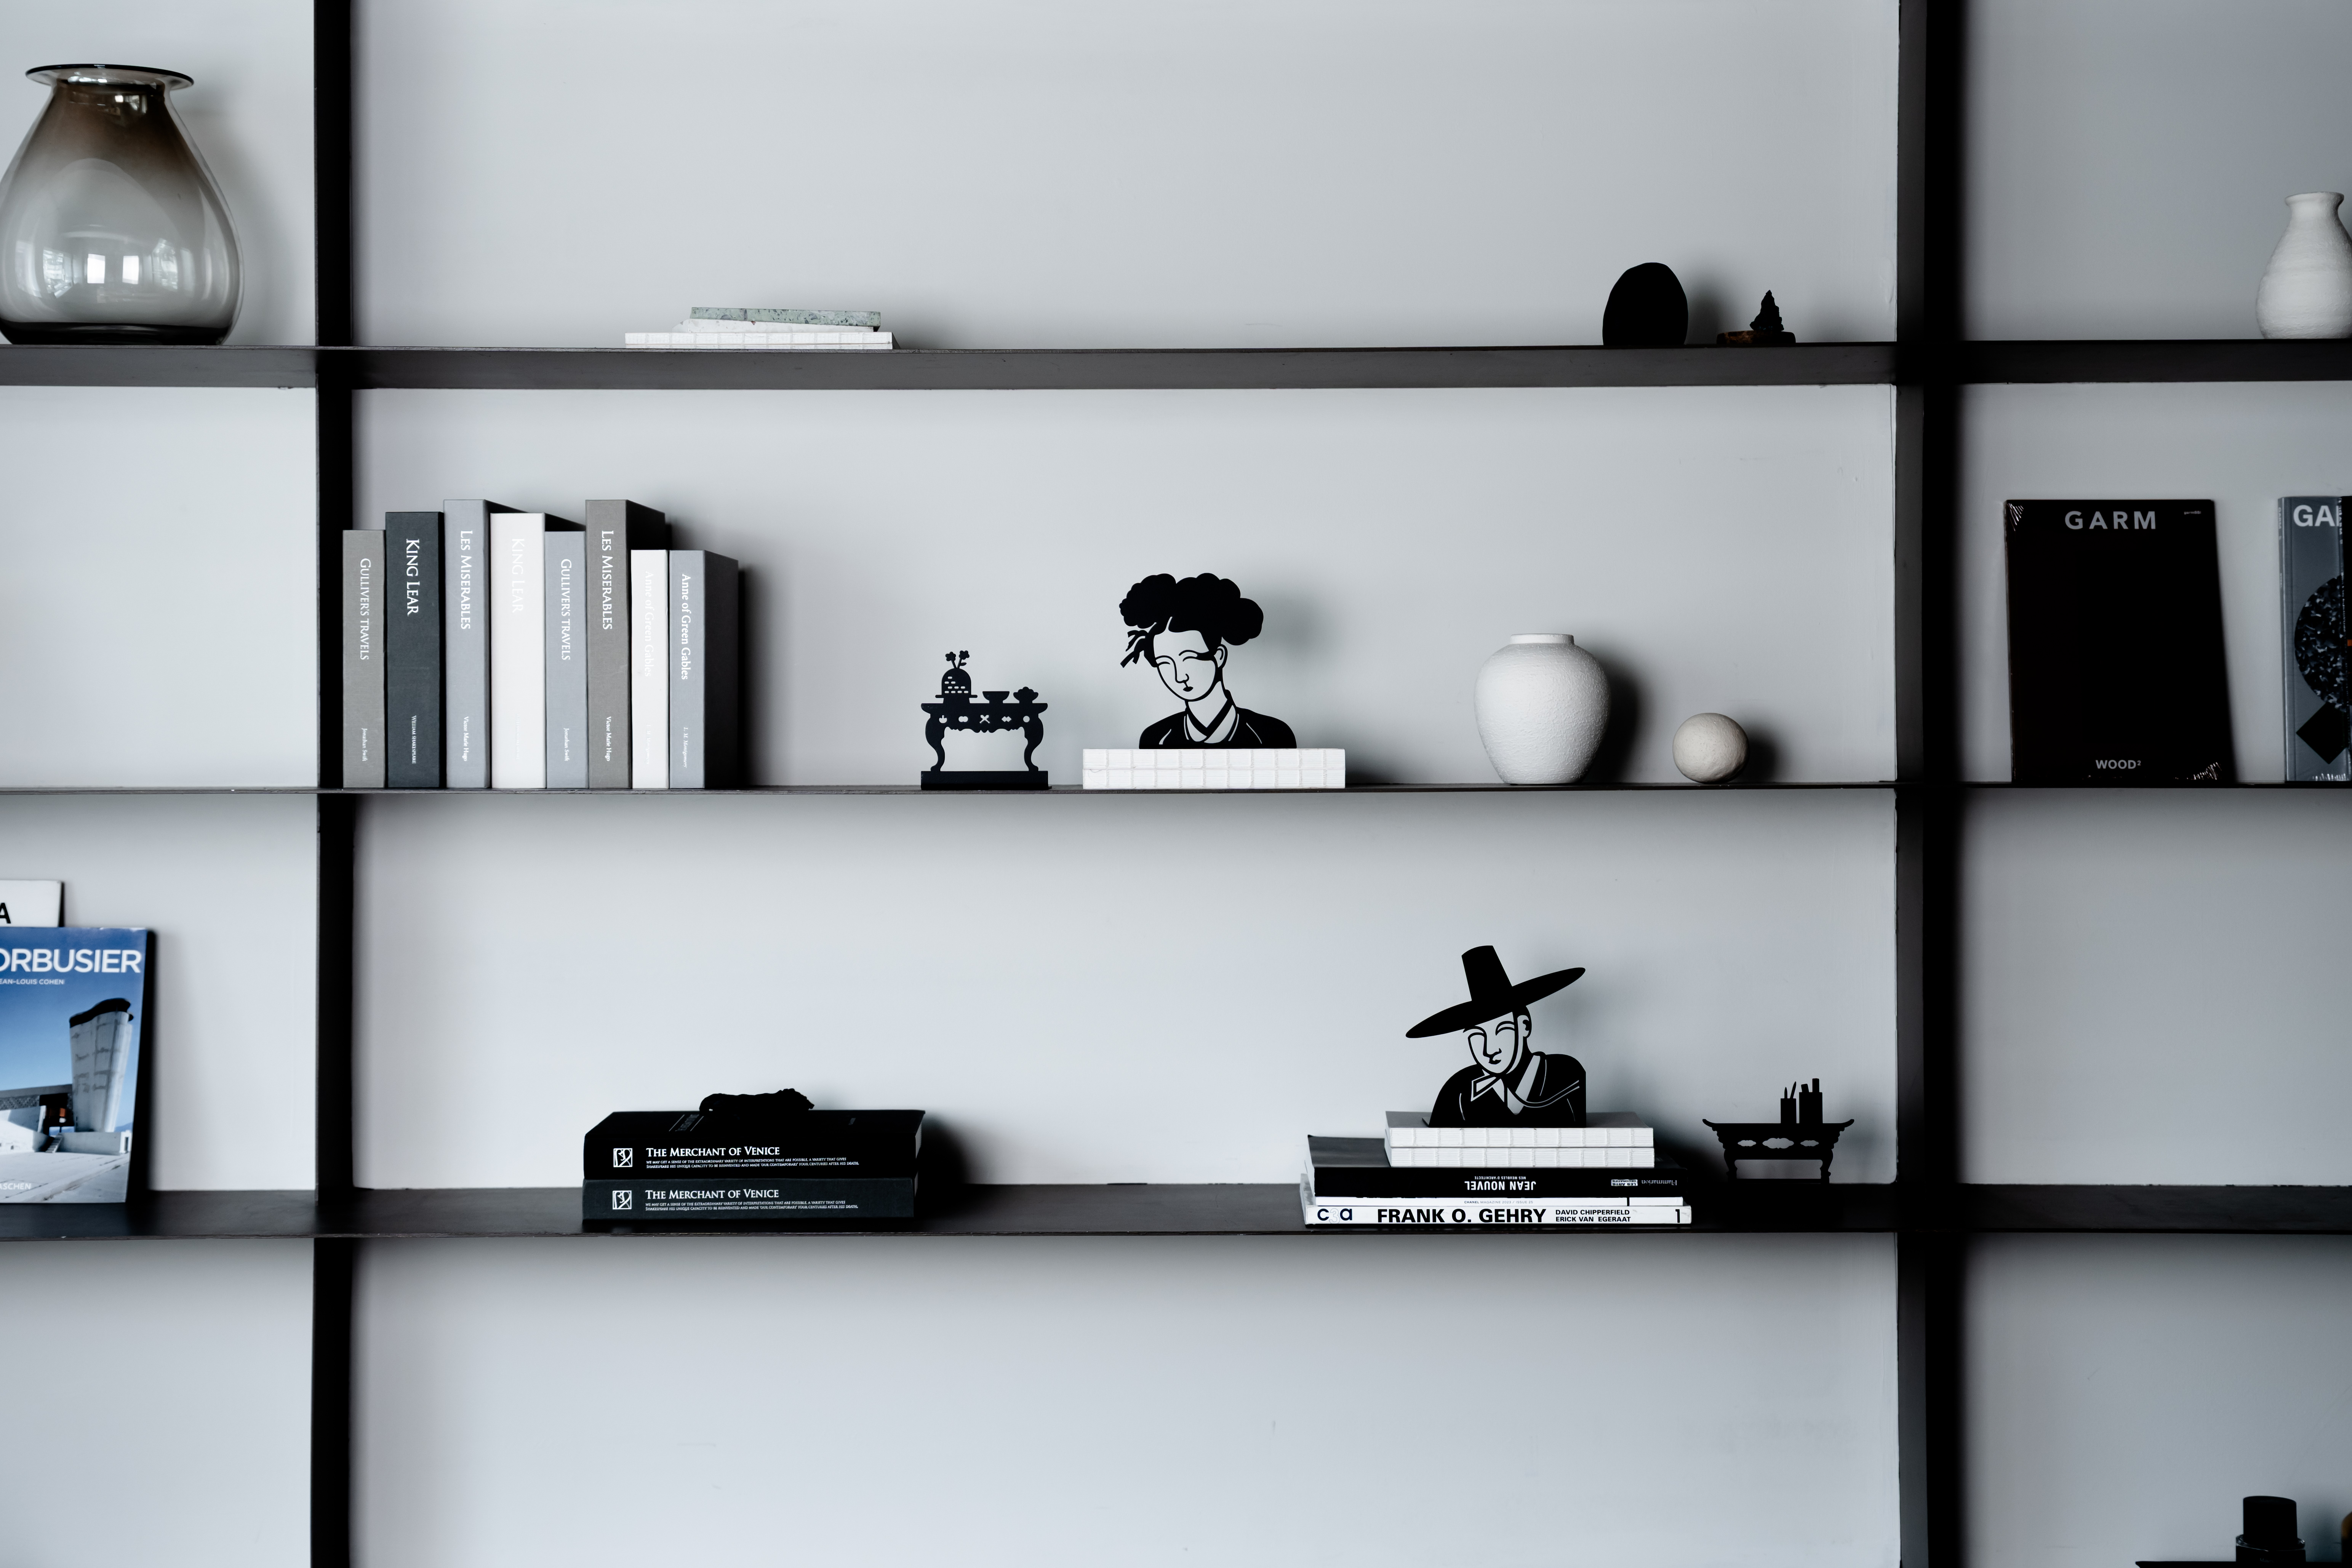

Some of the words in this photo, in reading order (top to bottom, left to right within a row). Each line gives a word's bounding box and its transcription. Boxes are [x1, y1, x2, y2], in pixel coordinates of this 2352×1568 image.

[2065, 510, 2156, 530] GARM
[2293, 504, 2339, 527] GA
[461, 530, 473, 550] LES
[602, 530, 614, 551] LES
[406, 538, 420, 577] KING
[512, 538, 525, 574] KING
[360, 558, 371, 616] GULLIVER'S
[461, 555, 472, 629] MISERABLES
[512, 580, 525, 613] LEAR
[561, 558, 572, 616] GULLIVER'S
[602, 555, 613, 630] MISERABLES
[645, 571, 654, 597] Anne
[682, 573, 691, 600] Anne
[406, 581, 420, 616] LEAR
[645, 600, 655, 611] of
[682, 602, 692, 614] of
[360, 618, 369, 660] TRAVELS
[561, 618, 571, 660] TRAVELS
[645, 612, 654, 641] Green
[681, 615, 691, 645] Green
[644, 644, 654, 677] Gables
[681, 647, 691, 680] Gables
[646, 1148, 667, 1157] THE
[669, 1147, 726, 1157] MERCHANT
[728, 1147, 742, 1156] OF
[744, 1146, 780, 1155] VENICE
[645, 1190, 666, 1199] THE
[669, 1190, 725, 1199] MERCHANT
[728, 1190, 741, 1198] OF
[743, 1189, 779, 1198] VENICE
[1464, 1181, 1505, 1190] NOUVEL
[1510, 1181, 1536, 1190] JEAN
[1377, 1209, 1445, 1223] FRANK
[1451, 1209, 1471, 1223] O.
[1479, 1209, 1547, 1223] GEHRY
[1675, 1209, 1680, 1223] 1
